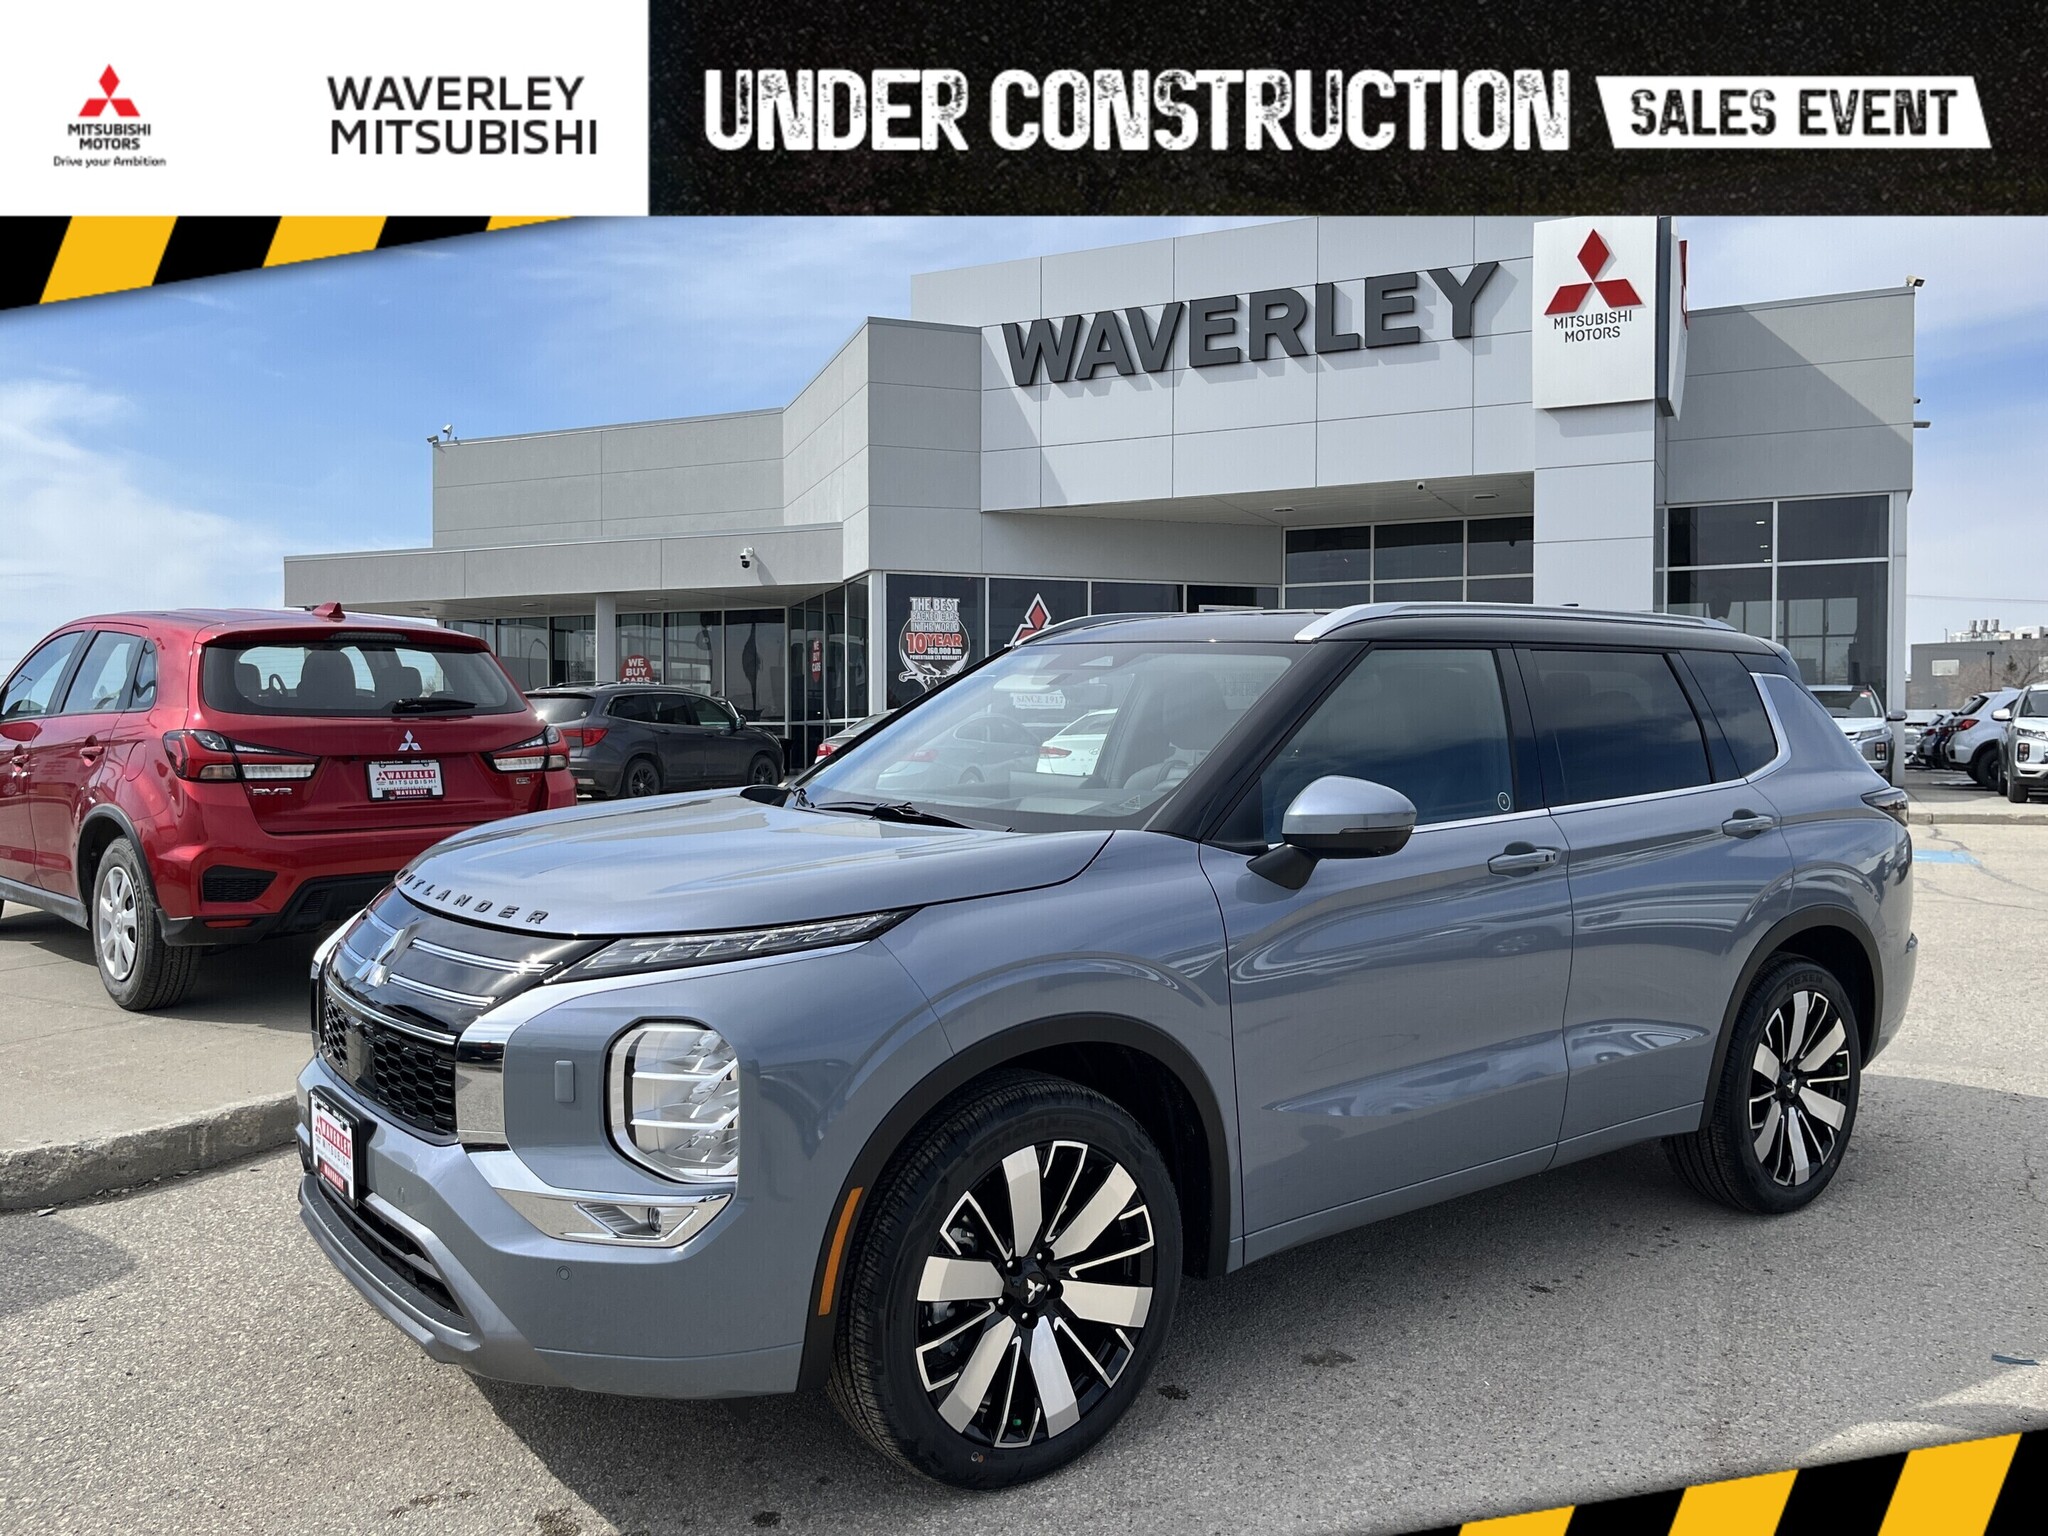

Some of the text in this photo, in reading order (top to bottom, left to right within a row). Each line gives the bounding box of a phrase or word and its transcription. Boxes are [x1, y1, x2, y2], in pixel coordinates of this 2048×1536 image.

[1001, 261, 1499, 387] WAVERLEY
[1553, 309, 1633, 330] MITSUBISHI
[1564, 325, 1621, 343] MOTORS
[910, 598, 960, 612] THE BEST
[911, 611, 960, 621] BACKED CARS
[920, 621, 934, 632] THE
[934, 621, 960, 632] WORLD
[906, 632, 963, 654] 10 YEAR
[628, 658, 644, 667] WE
[626, 667, 647, 677] BUY
[1016, 695, 1043, 704] SINCE
[386, 770, 435, 779] WAVERLEY
[252, 787, 292, 796] RVR
[397, 868, 549, 925] OUTLANDER
